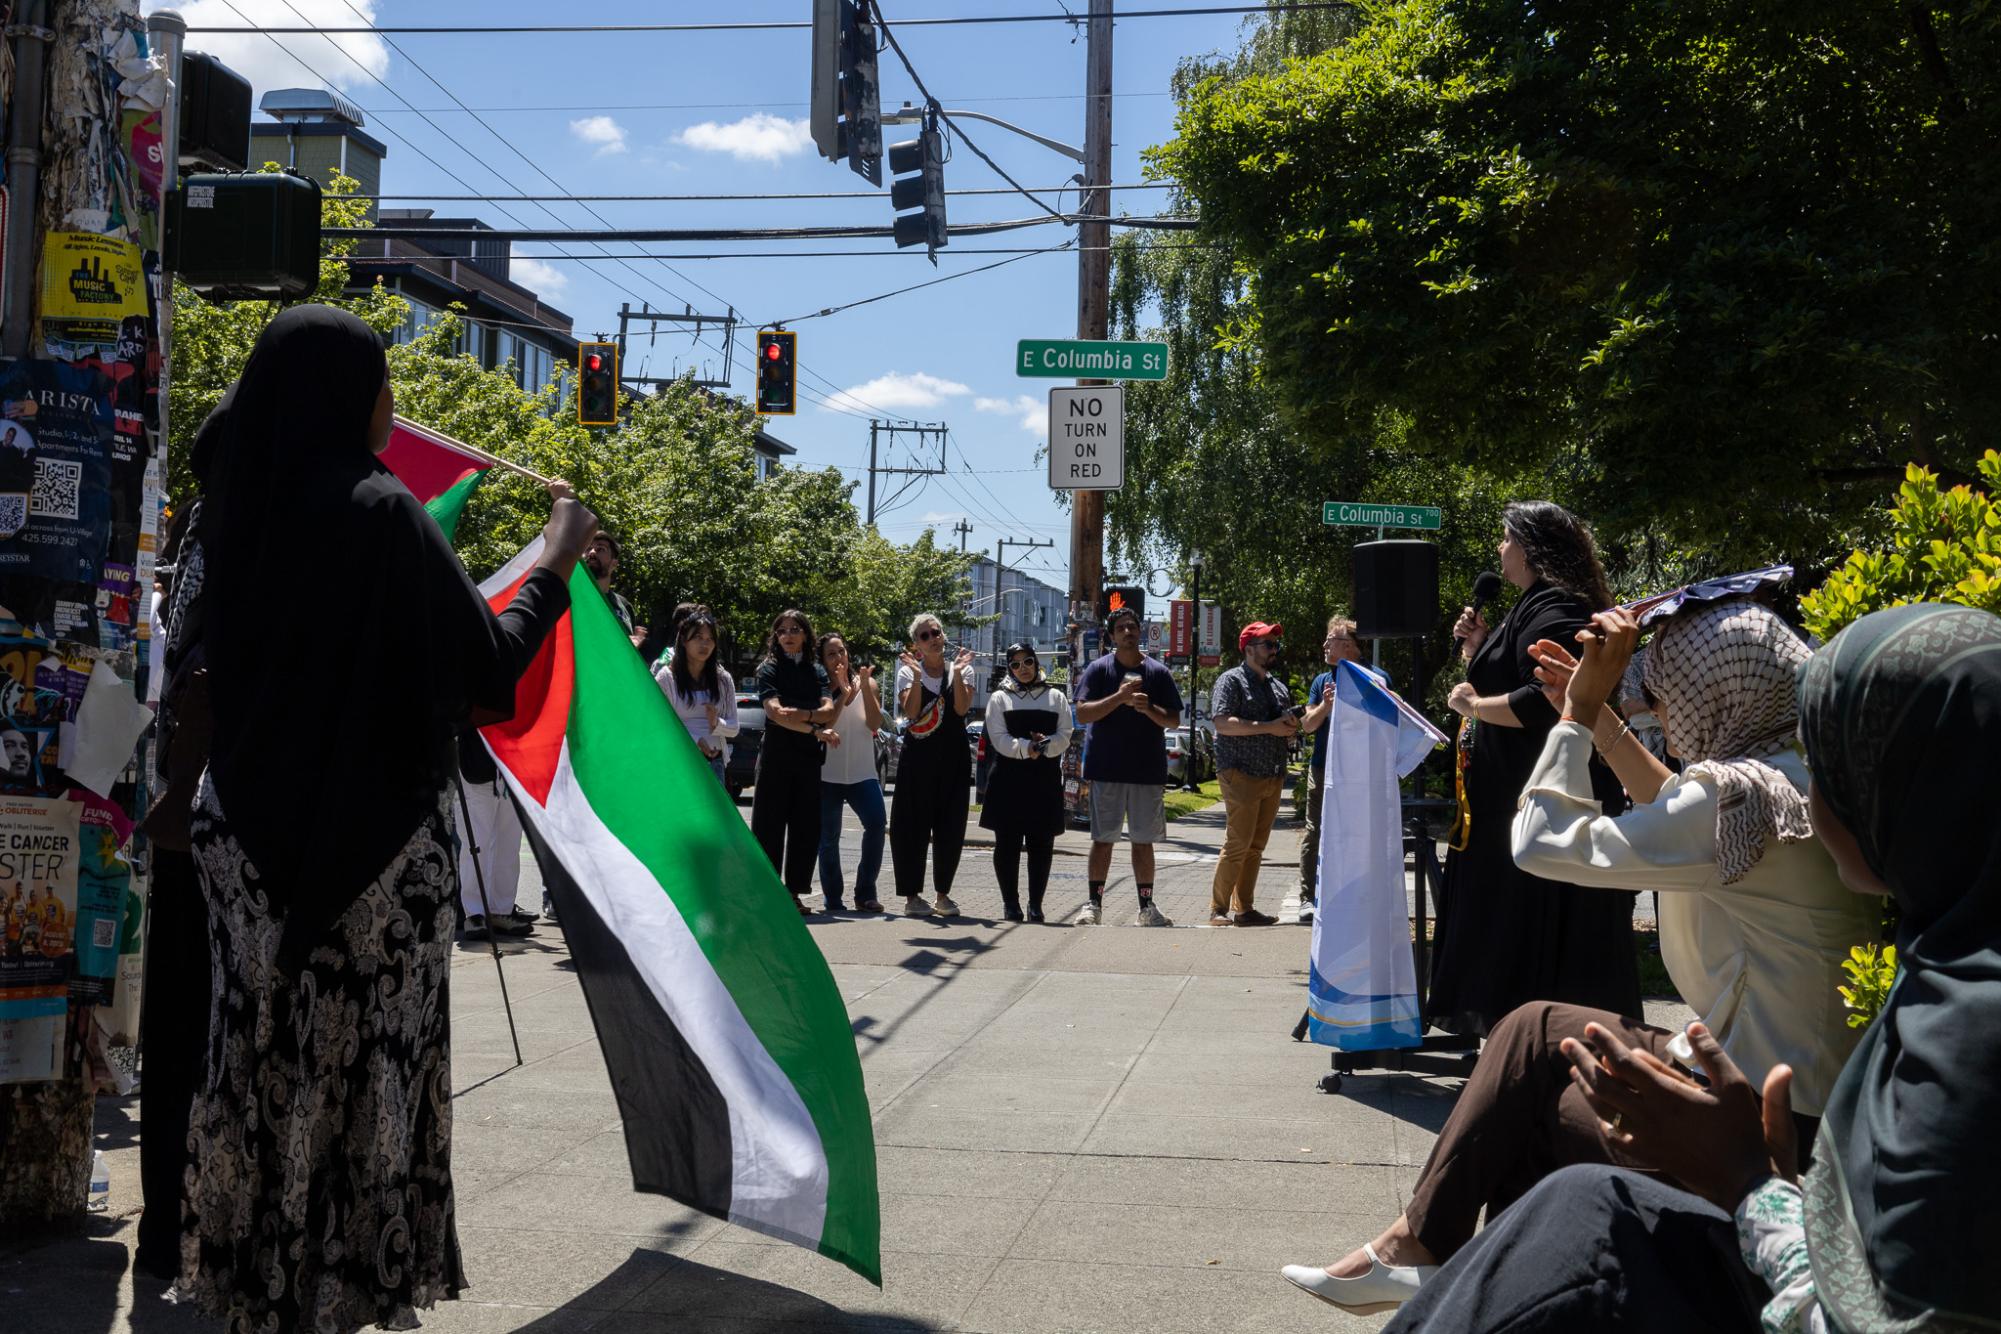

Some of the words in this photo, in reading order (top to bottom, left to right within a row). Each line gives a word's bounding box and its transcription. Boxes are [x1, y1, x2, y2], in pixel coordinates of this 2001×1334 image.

[73, 279, 106, 292] MUSIC
[80, 290, 115, 300] FACTORY
[1023, 351, 1034, 368] E
[1043, 348, 1132, 370] Columbia
[1142, 353, 1161, 371] St
[1070, 398, 1102, 417] NO
[1064, 423, 1107, 437] TURN
[1075, 443, 1096, 458] ON
[1070, 463, 1102, 478] RED
[1328, 509, 1335, 521] E
[1340, 505, 1405, 524] Columbia
[1410, 513, 1423, 525] St
[1425, 509, 1439, 517] 700
[11, 835, 69, 851] CANCER
